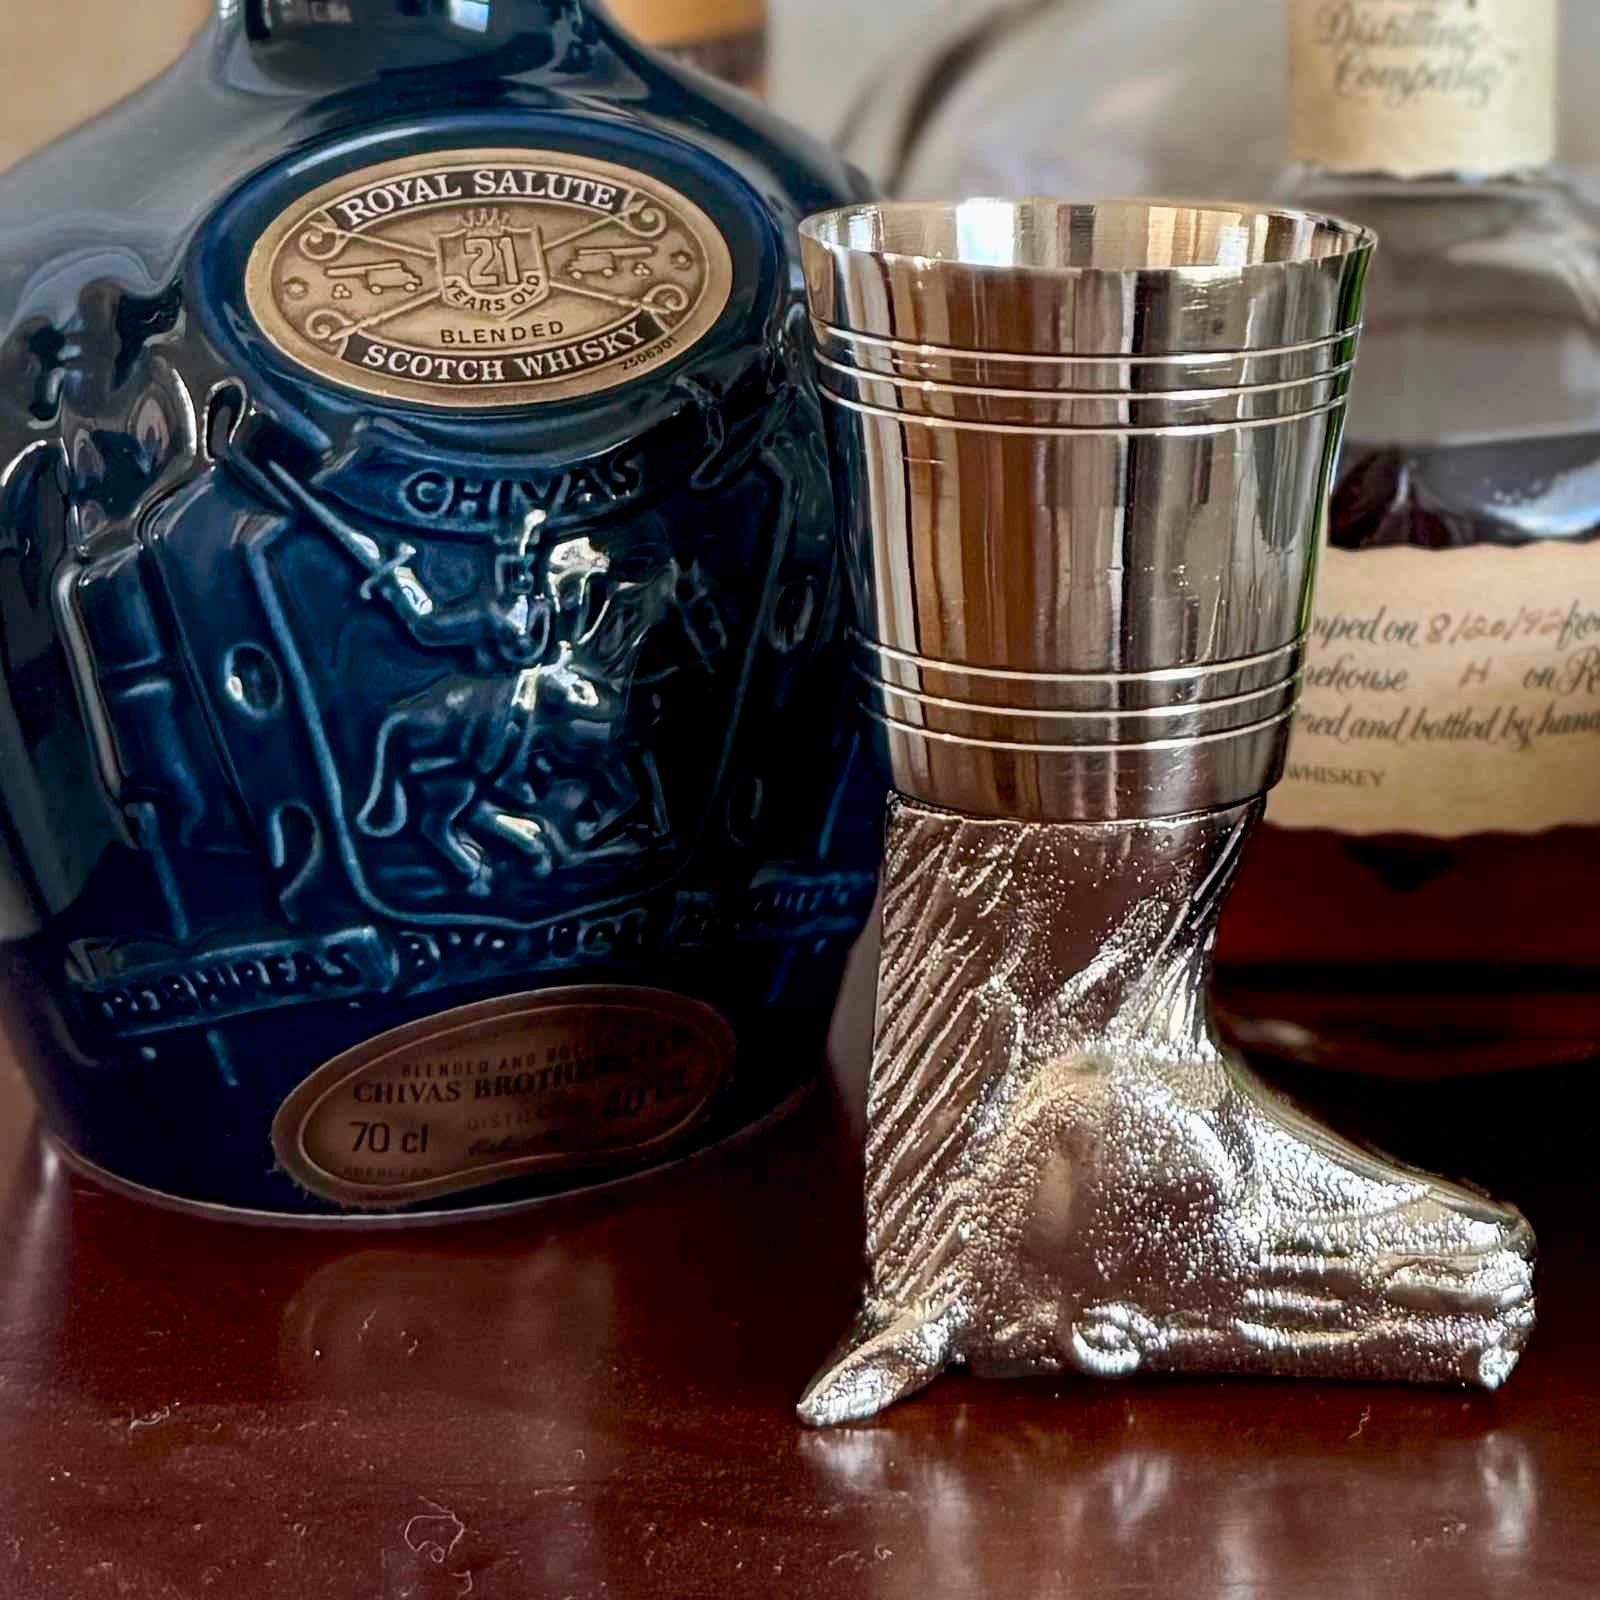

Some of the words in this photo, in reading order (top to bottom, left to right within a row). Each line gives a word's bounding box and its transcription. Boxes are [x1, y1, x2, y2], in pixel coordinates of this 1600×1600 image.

[336, 172, 462, 227] ROYAL
[474, 170, 617, 211] SALUTE
[463, 236, 521, 288] 21
[445, 279, 506, 312] YEARS
[510, 274, 541, 305] OLD
[361, 343, 505, 381] SCOTCH
[513, 316, 646, 377] WHISKY
[440, 320, 564, 344] BLENDED
[401, 456, 643, 517] CHIVAS
[1384, 618, 1420, 647] on
[1522, 667, 1555, 691] on
[1351, 705, 1410, 748] and
[1410, 705, 1502, 744] bottled
[1500, 704, 1534, 751] by
[403, 1060, 489, 1079] BLENDED
[499, 1053, 537, 1071] AND
[353, 1080, 462, 1104] CHIVAS
[349, 1120, 391, 1153] 70
[401, 1123, 430, 1154] cl
